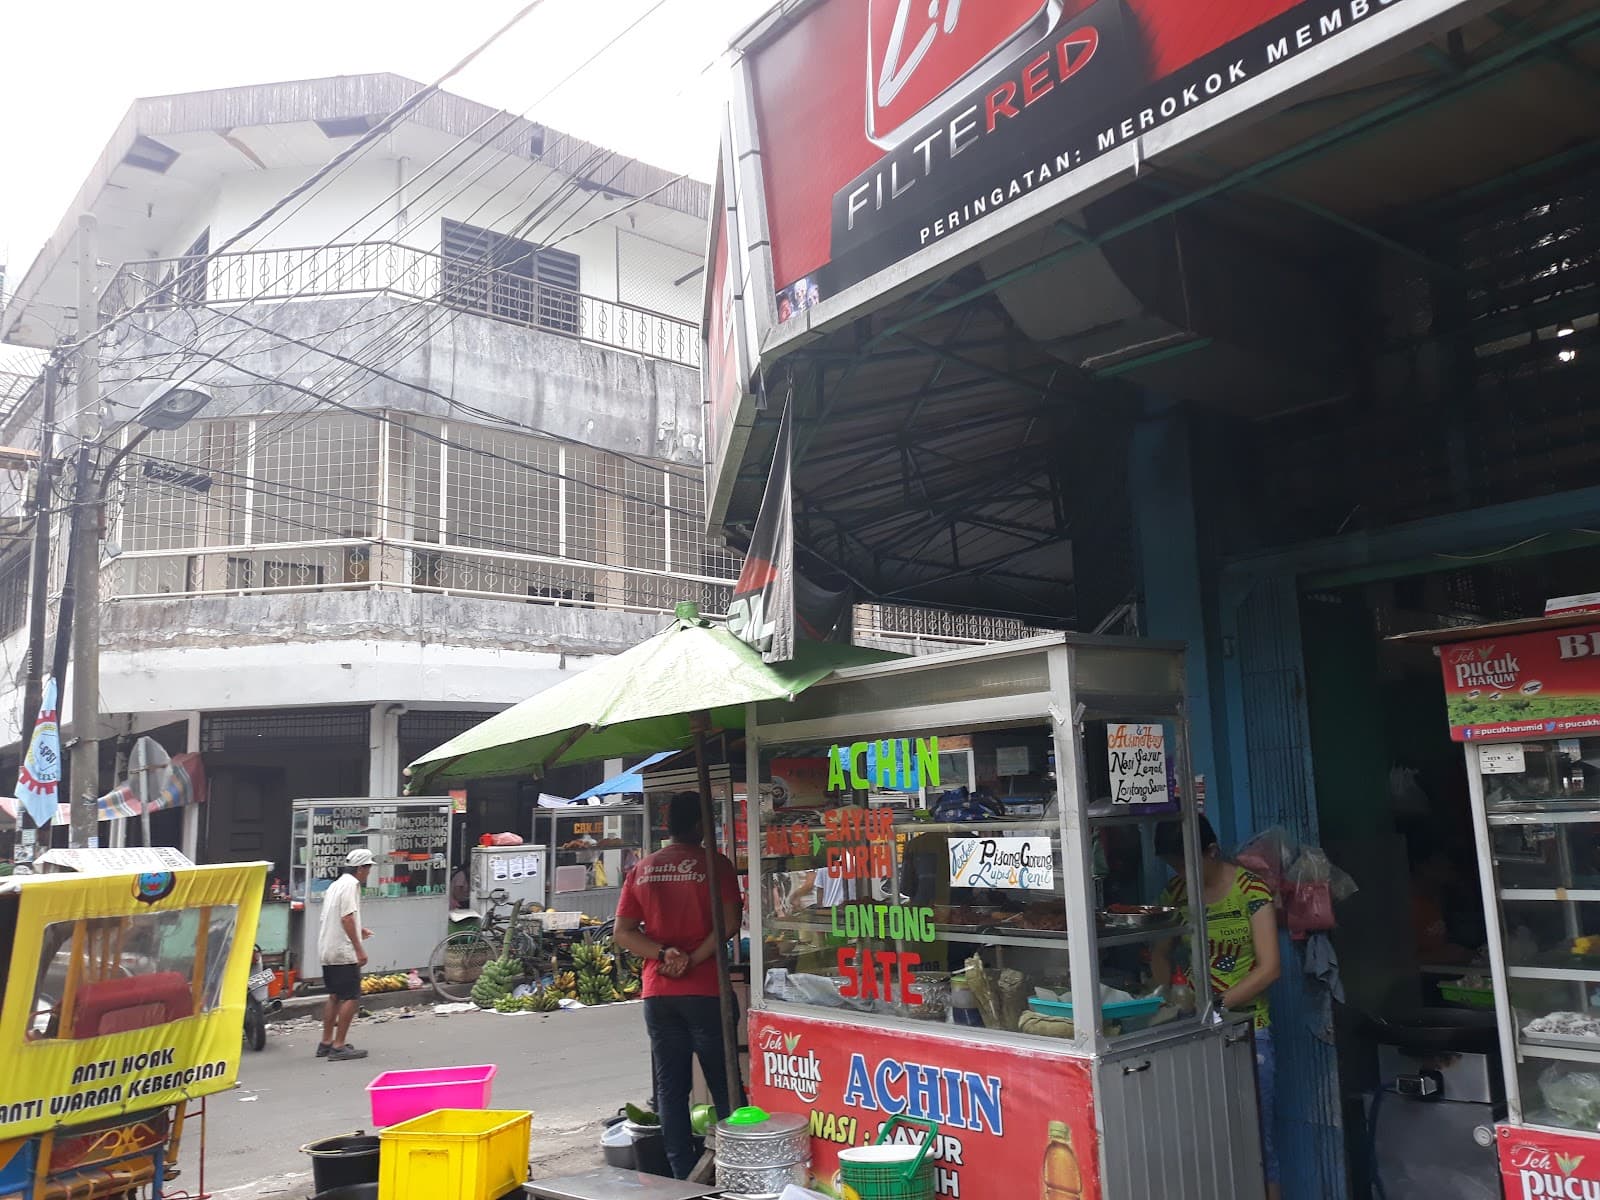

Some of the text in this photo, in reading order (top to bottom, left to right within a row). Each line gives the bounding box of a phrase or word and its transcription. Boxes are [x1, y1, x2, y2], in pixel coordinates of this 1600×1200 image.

[848, 25, 1099, 231] FILTERED
[919, 0, 1400, 245] PERINGATAN: MEROKOK MEMB
[1456, 652, 1520, 688] pucuk
[1468, 673, 1516, 689] HARUM
[827, 736, 941, 792] ACHIN
[1111, 752, 1134, 775] Nasi
[313, 815, 333, 827] MIE
[332, 819, 361, 831] KUAH
[766, 808, 895, 856] NASI SAYUR
[643, 859, 697, 875] Youth &
[826, 845, 893, 880] GURIH
[979, 839, 1021, 869] Pisang
[312, 866, 338, 878] NASI
[637, 871, 706, 886] Community
[831, 903, 936, 943] LONTONG
[836, 947, 925, 1005] SATE
[759, 1025, 783, 1051] Teh
[71, 1060, 116, 1085] ANTI
[763, 1049, 822, 1087] pucuk
[774, 1074, 819, 1097] HARUM
[843, 1052, 1004, 1137] ACHIN
[0, 1098, 44, 1125] ANTI
[49, 1083, 122, 1116] UJARAN
[808, 1109, 857, 1147] NASI
[1511, 1144, 1553, 1171] Teh
